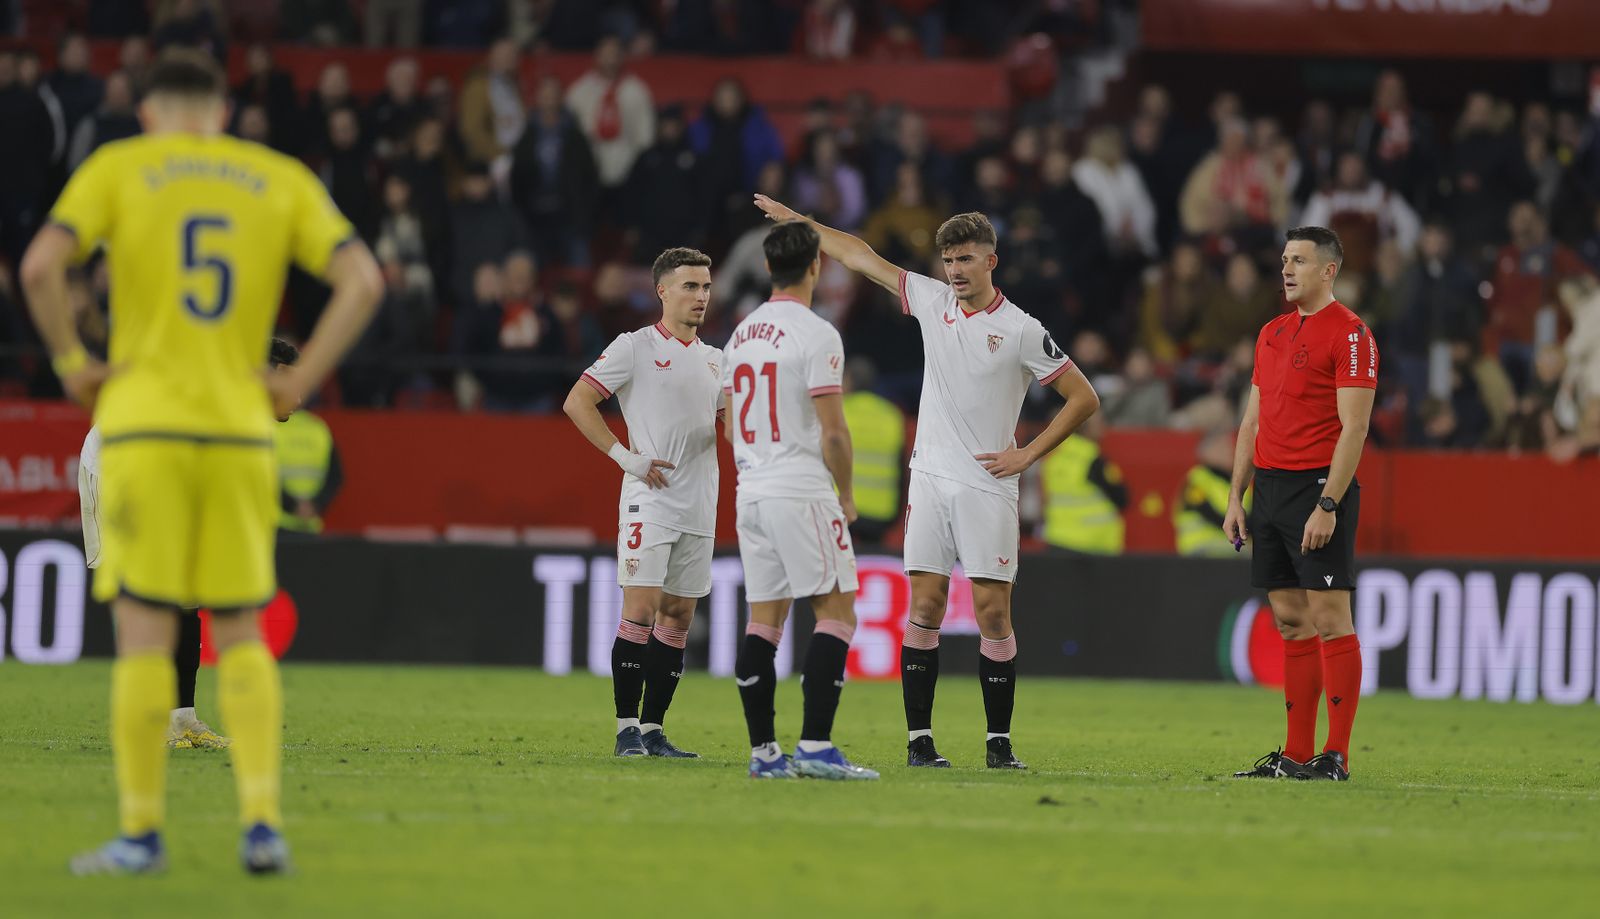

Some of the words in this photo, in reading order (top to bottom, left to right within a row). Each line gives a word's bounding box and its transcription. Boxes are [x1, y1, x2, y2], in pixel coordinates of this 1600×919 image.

[183, 215, 231, 321] 5
[733, 362, 780, 444] 21
[627, 522, 643, 549] 3
[1356, 568, 1600, 706] POMO
